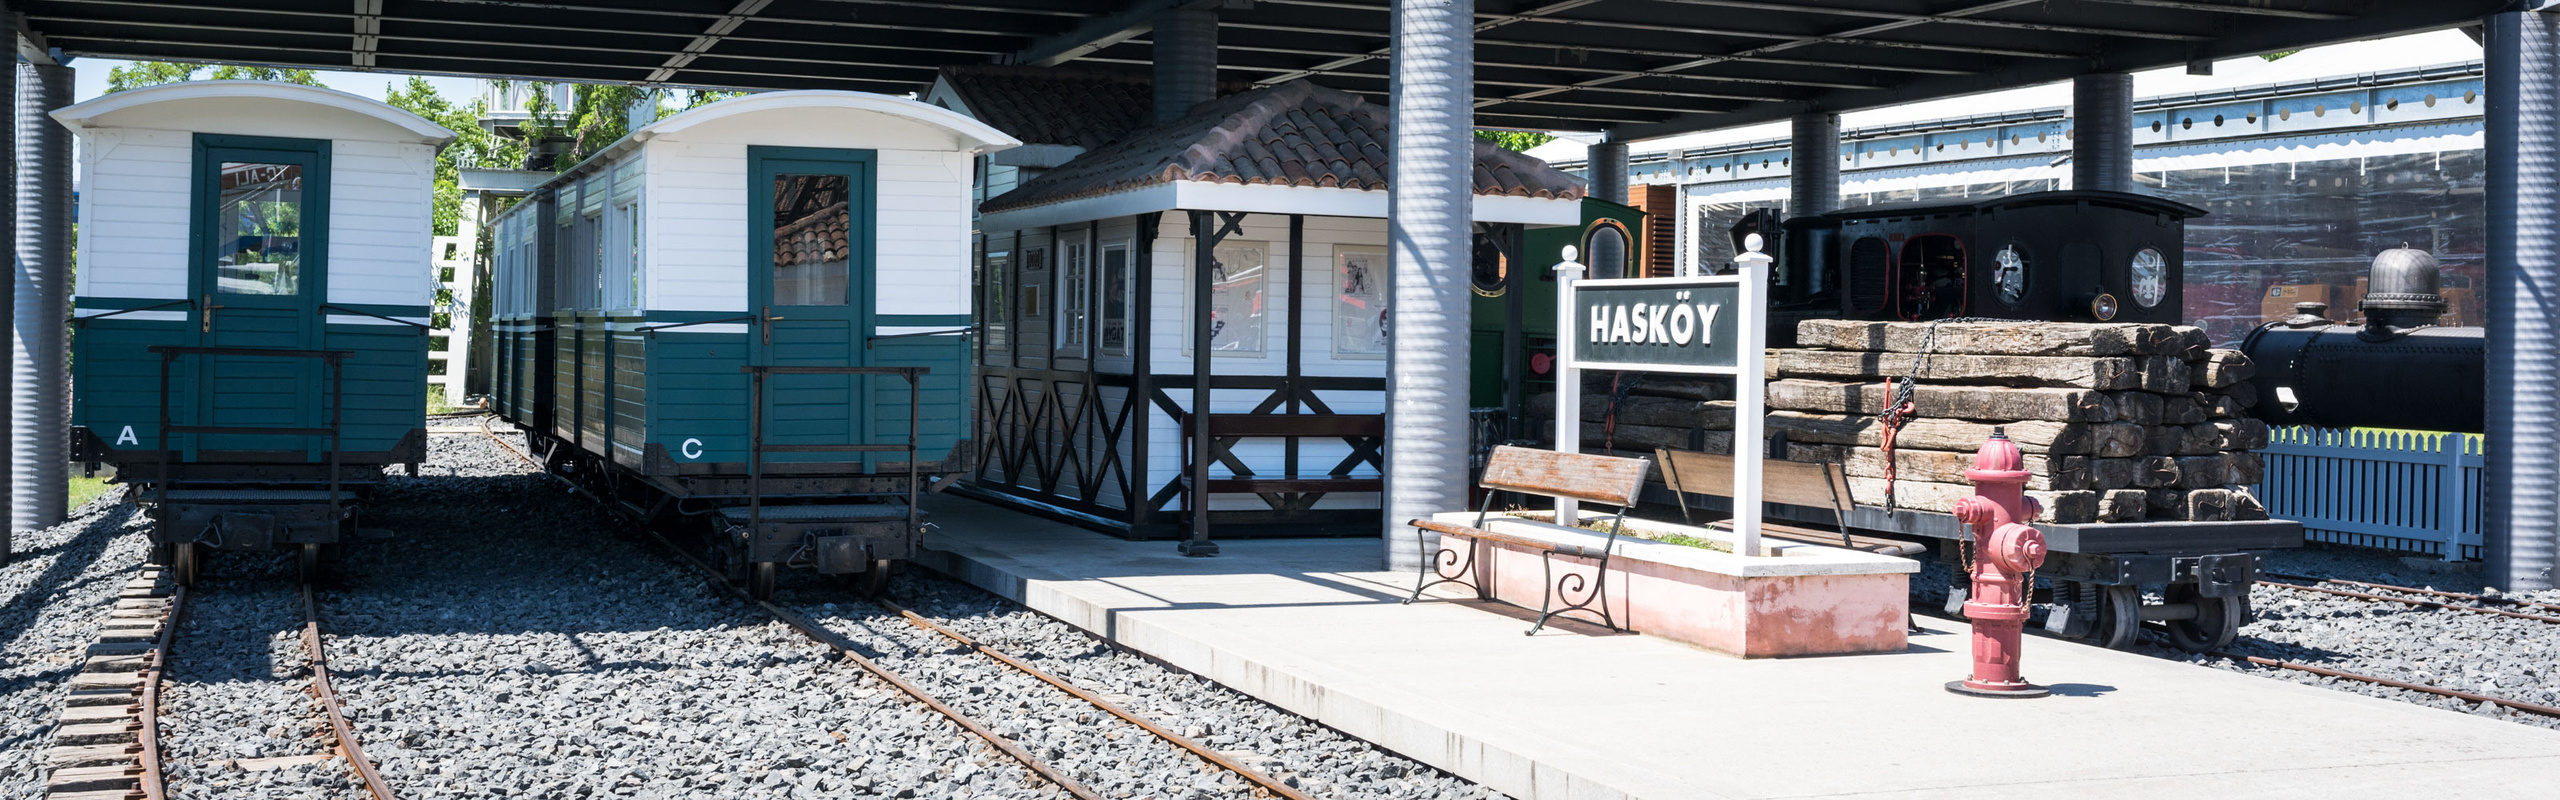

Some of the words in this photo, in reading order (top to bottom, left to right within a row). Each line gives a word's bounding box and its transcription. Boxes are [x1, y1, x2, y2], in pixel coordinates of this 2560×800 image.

[1590, 290, 1720, 347] HASKÖY
[116, 425, 139, 445] A
[681, 437, 703, 460] C
